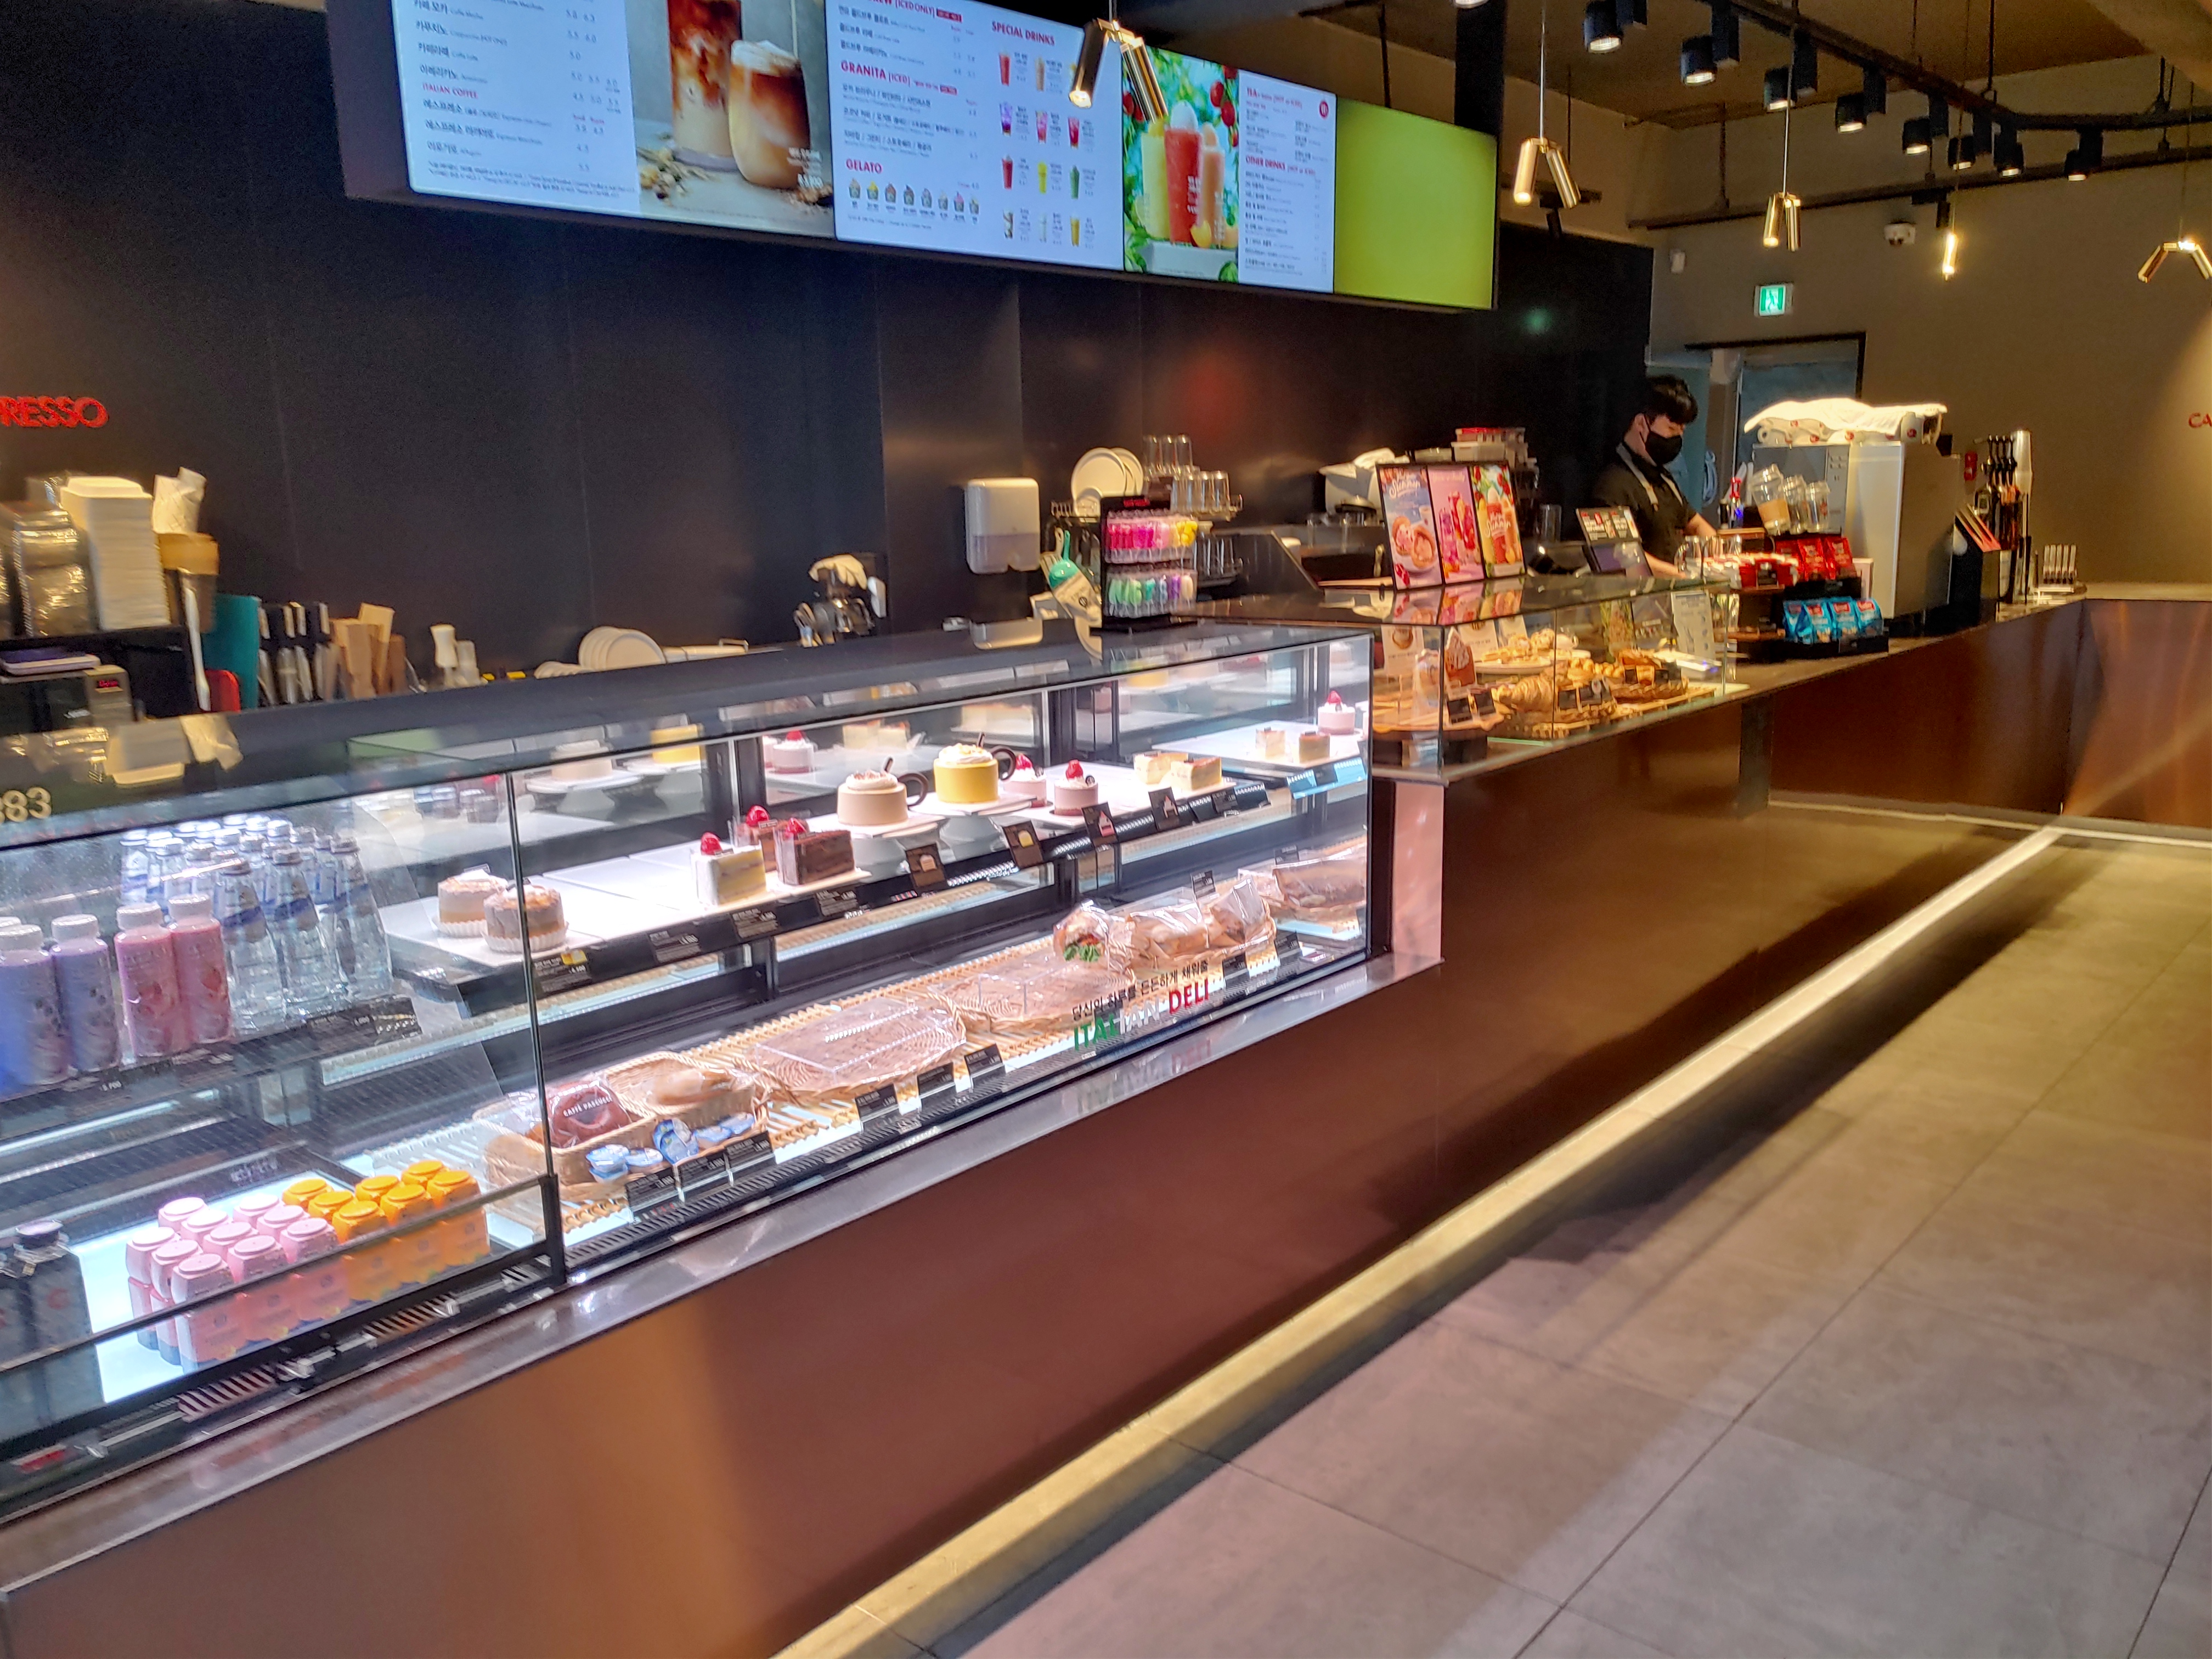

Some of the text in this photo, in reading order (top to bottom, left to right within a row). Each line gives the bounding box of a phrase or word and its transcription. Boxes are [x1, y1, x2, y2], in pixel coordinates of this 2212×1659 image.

[992, 20, 1056, 46] SPECIAL DRINKS
[841, 59, 911, 88] GRANITA [ICED]
[422, 82, 479, 99] ITALIAN COFFEE
[845, 157, 883, 174] GELATO
[0, 395, 109, 428] RESSO
[0, 786, 52, 822] 83
[1071, 996, 1104, 1022] 당신의
[1108, 984, 1136, 1008] 하루를
[1141, 968, 1178, 996] 든든하게
[1074, 978, 1210, 1052] ITALIAN DELI
